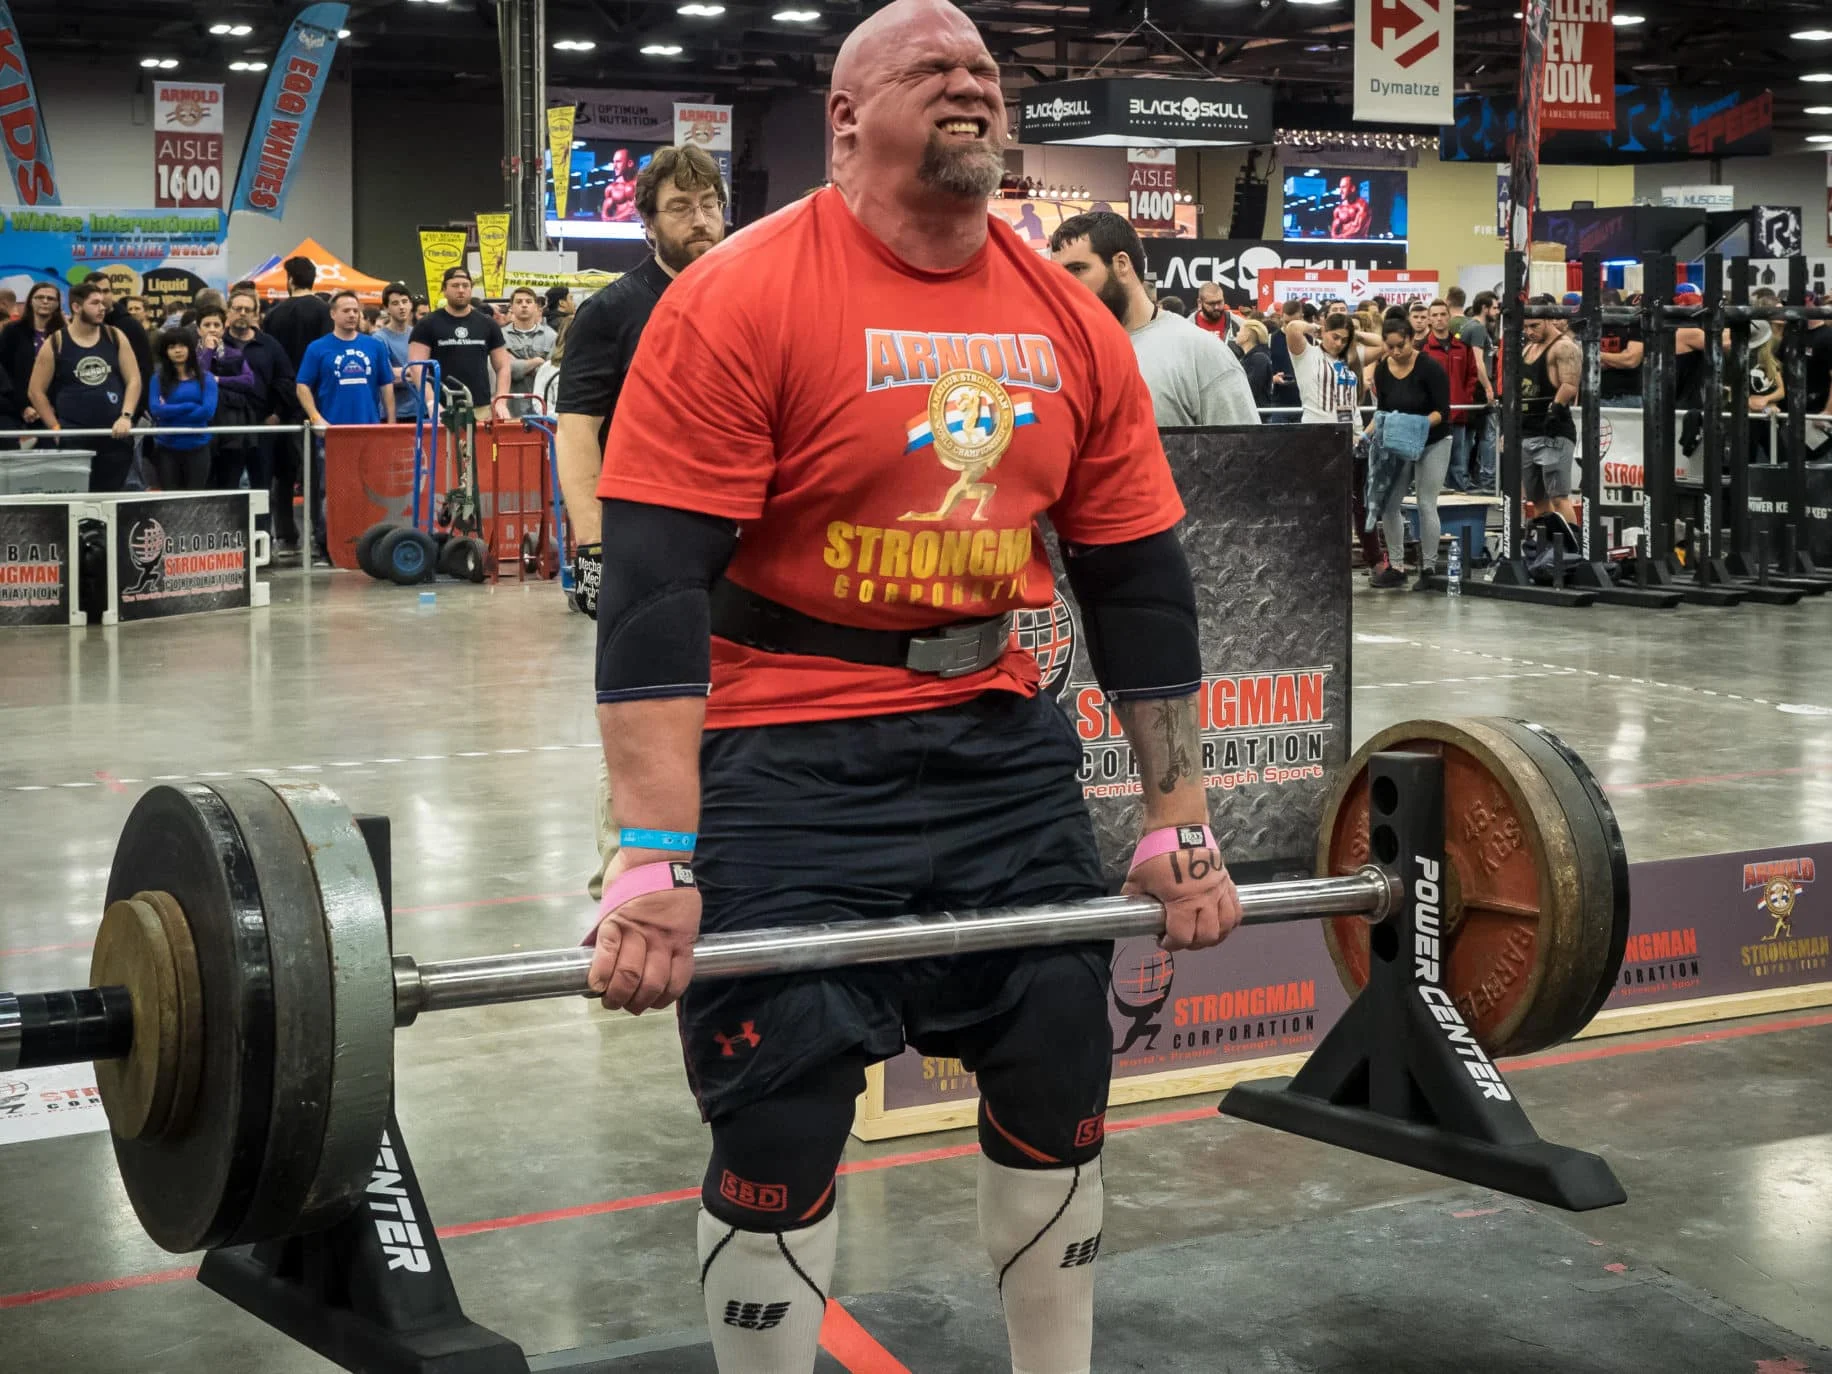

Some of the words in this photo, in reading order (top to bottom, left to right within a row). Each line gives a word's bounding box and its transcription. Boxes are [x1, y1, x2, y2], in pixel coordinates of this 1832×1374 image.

[1547, 21, 1584, 62] EW
[159, 88, 219, 105] ARNOLD
[276, 56, 319, 115] EGG
[1370, 78, 1440, 97] Dymatize
[1542, 62, 1601, 104] OOK.
[598, 104, 649, 116] OPTIMUM
[599, 115, 658, 126] NUTRITION
[679, 109, 729, 123] ARNOLD
[1062, 101, 1091, 116] SKULL
[1129, 98, 1181, 116] BLACK
[1199, 102, 1249, 119] SKULL
[159, 140, 218, 161] AISLE
[250, 119, 300, 210] WHITES
[158, 165, 221, 201] 1600
[1130, 169, 1173, 188] AISLE
[1129, 190, 1174, 221] 1400
[11, 211, 84, 232] Whites
[89, 212, 220, 233] International
[148, 278, 189, 293] Liquid
[1145, 256, 1235, 290] LACK
[865, 328, 1062, 392] ARNOLD
[960, 373, 1010, 410] STRONGMAN
[1604, 461, 1644, 486] STRON
[1747, 501, 1774, 513] OWER
[1775, 501, 1789, 513] KE
[7, 543, 60, 562] BAL
[164, 530, 243, 554] GLOBAL
[824, 520, 1032, 579] STRONGM
[0, 565, 60, 584] NGMAN
[165, 551, 244, 577] STRONGMAN
[2, 587, 60, 600] RATION
[1083, 780, 1144, 800] remie
[1201, 769, 1259, 791] ength
[1264, 764, 1323, 784] Sport
[1743, 857, 1816, 893] ARNOLD
[1415, 855, 1440, 985] POWER
[1625, 928, 1698, 964] NGMAN
[1741, 935, 1830, 967] STRONGMAN
[1623, 961, 1700, 986] ORATION
[1174, 979, 1316, 1028] STRONGMAN
[1173, 1014, 1315, 1050] CORPORATION
[1418, 985, 1513, 1101] CENTER
[365, 1129, 431, 1273] ENTER
[725, 1174, 781, 1208] SBD
